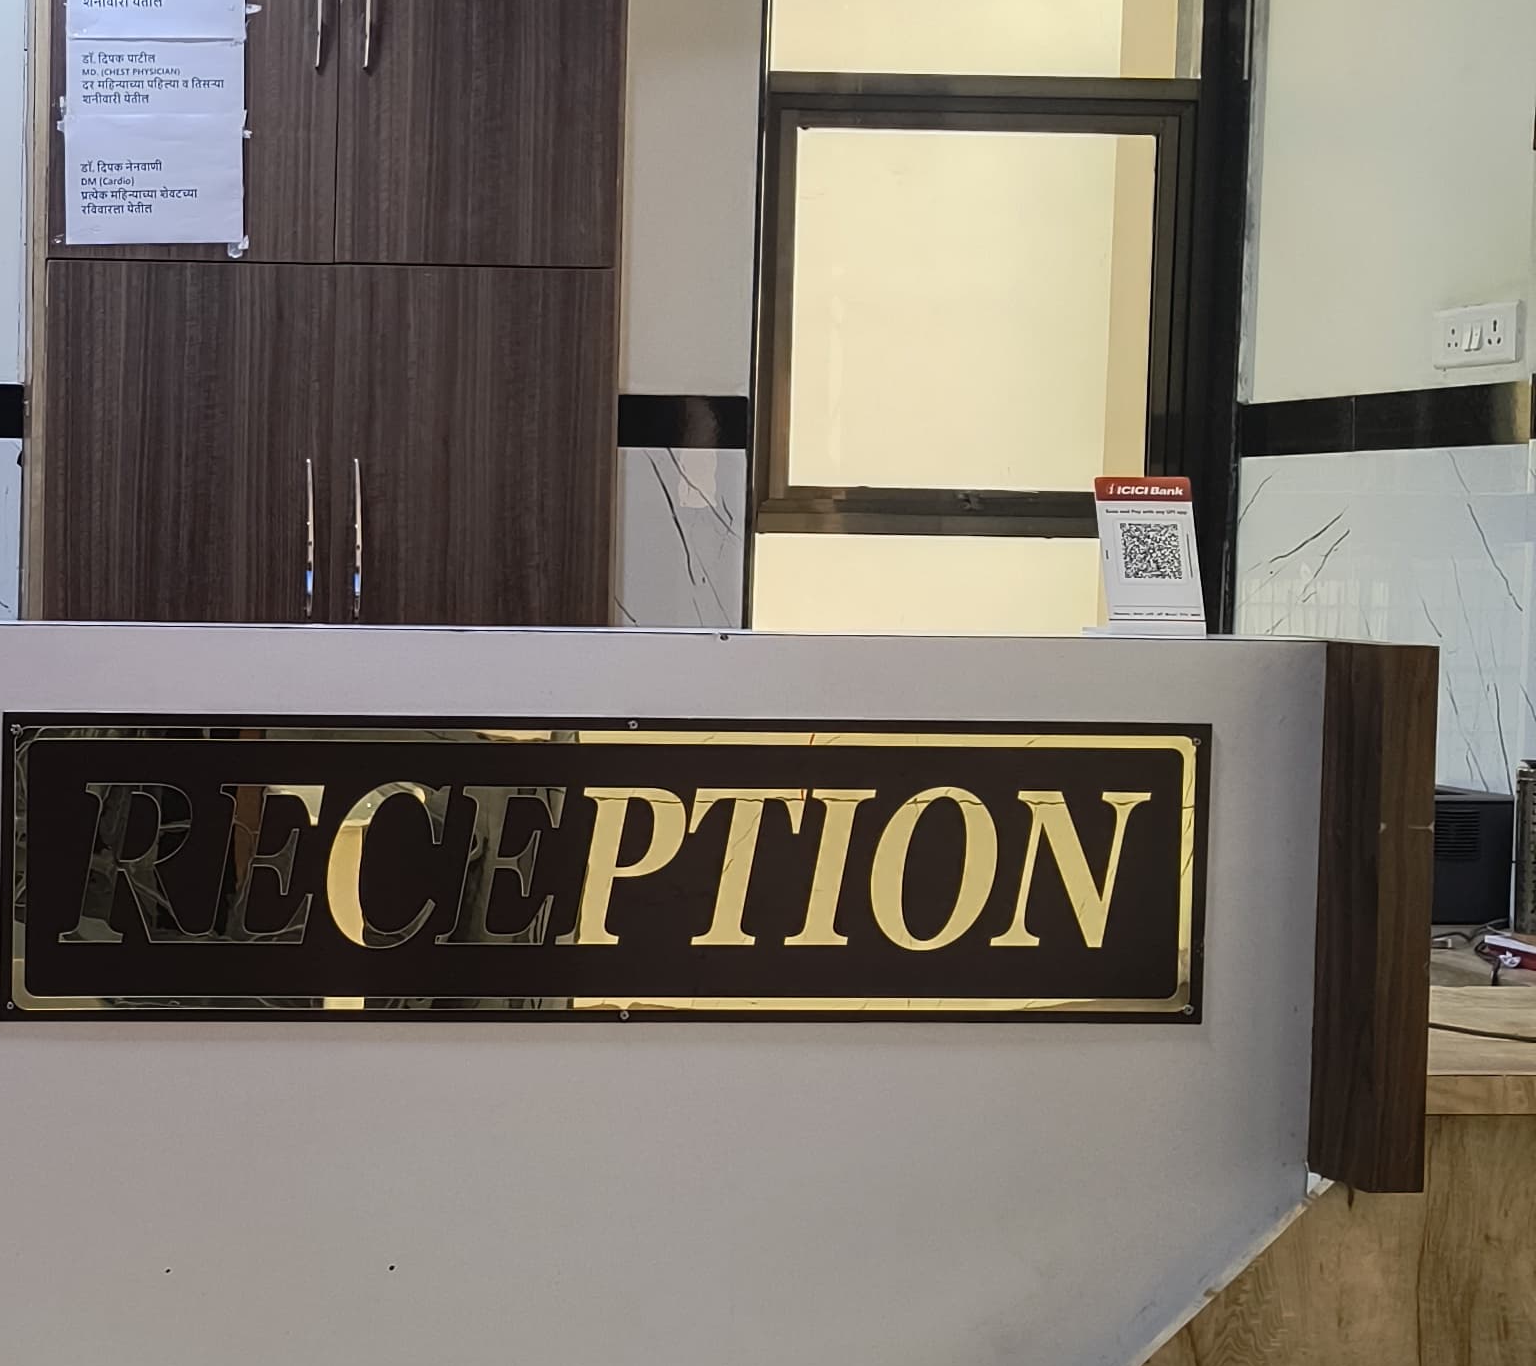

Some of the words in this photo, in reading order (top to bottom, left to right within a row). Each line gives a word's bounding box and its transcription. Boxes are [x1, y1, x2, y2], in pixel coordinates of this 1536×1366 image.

[99, 51, 124, 65] दिपक
[127, 51, 155, 64] पाटील
[101, 68, 130, 77] (CHEST
[133, 68, 181, 76] PHYSICIAN)
[82, 79, 94, 90] दर
[98, 77, 144, 92] महिन्याच्या
[147, 77, 179, 92] पहिल्या
[124, 92, 149, 104] येतील
[97, 160, 123, 173] दिपक
[81, 177, 96, 186] DM
[99, 177, 135, 187] (Cardio)
[1117, 485, 1148, 495] ICICI
[1150, 486, 1183, 496] Bank
[58, 781, 1152, 951] RECEPTION
